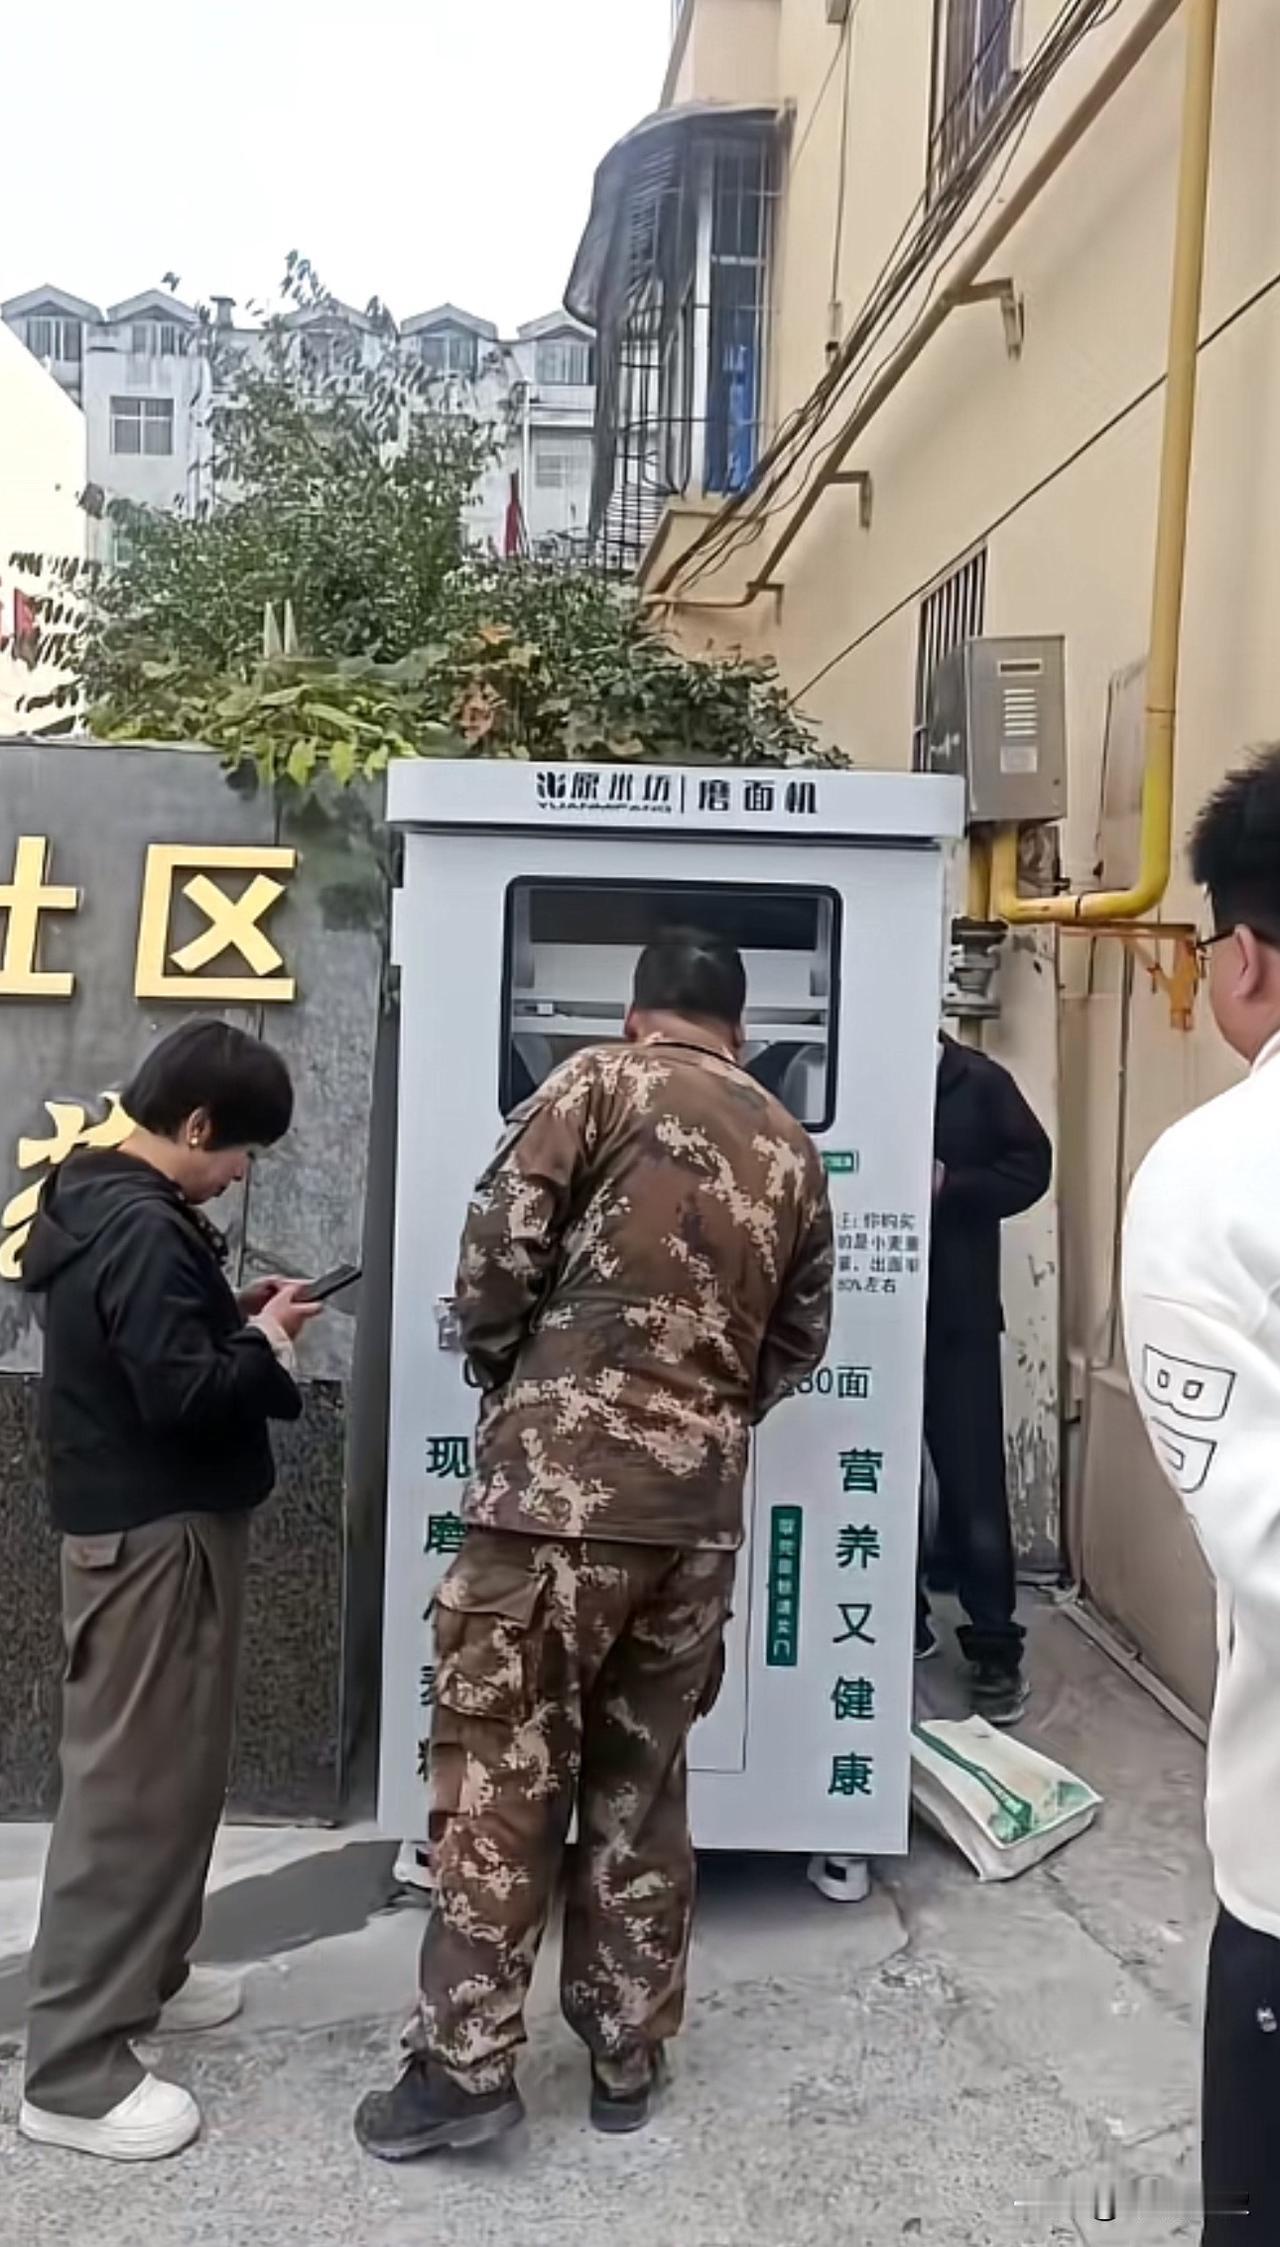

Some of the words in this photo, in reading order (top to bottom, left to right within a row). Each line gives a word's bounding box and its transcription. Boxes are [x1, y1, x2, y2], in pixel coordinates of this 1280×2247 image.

[699, 780, 817, 814] 磨面机
[828, 1448, 883, 1795] 营养又健康
